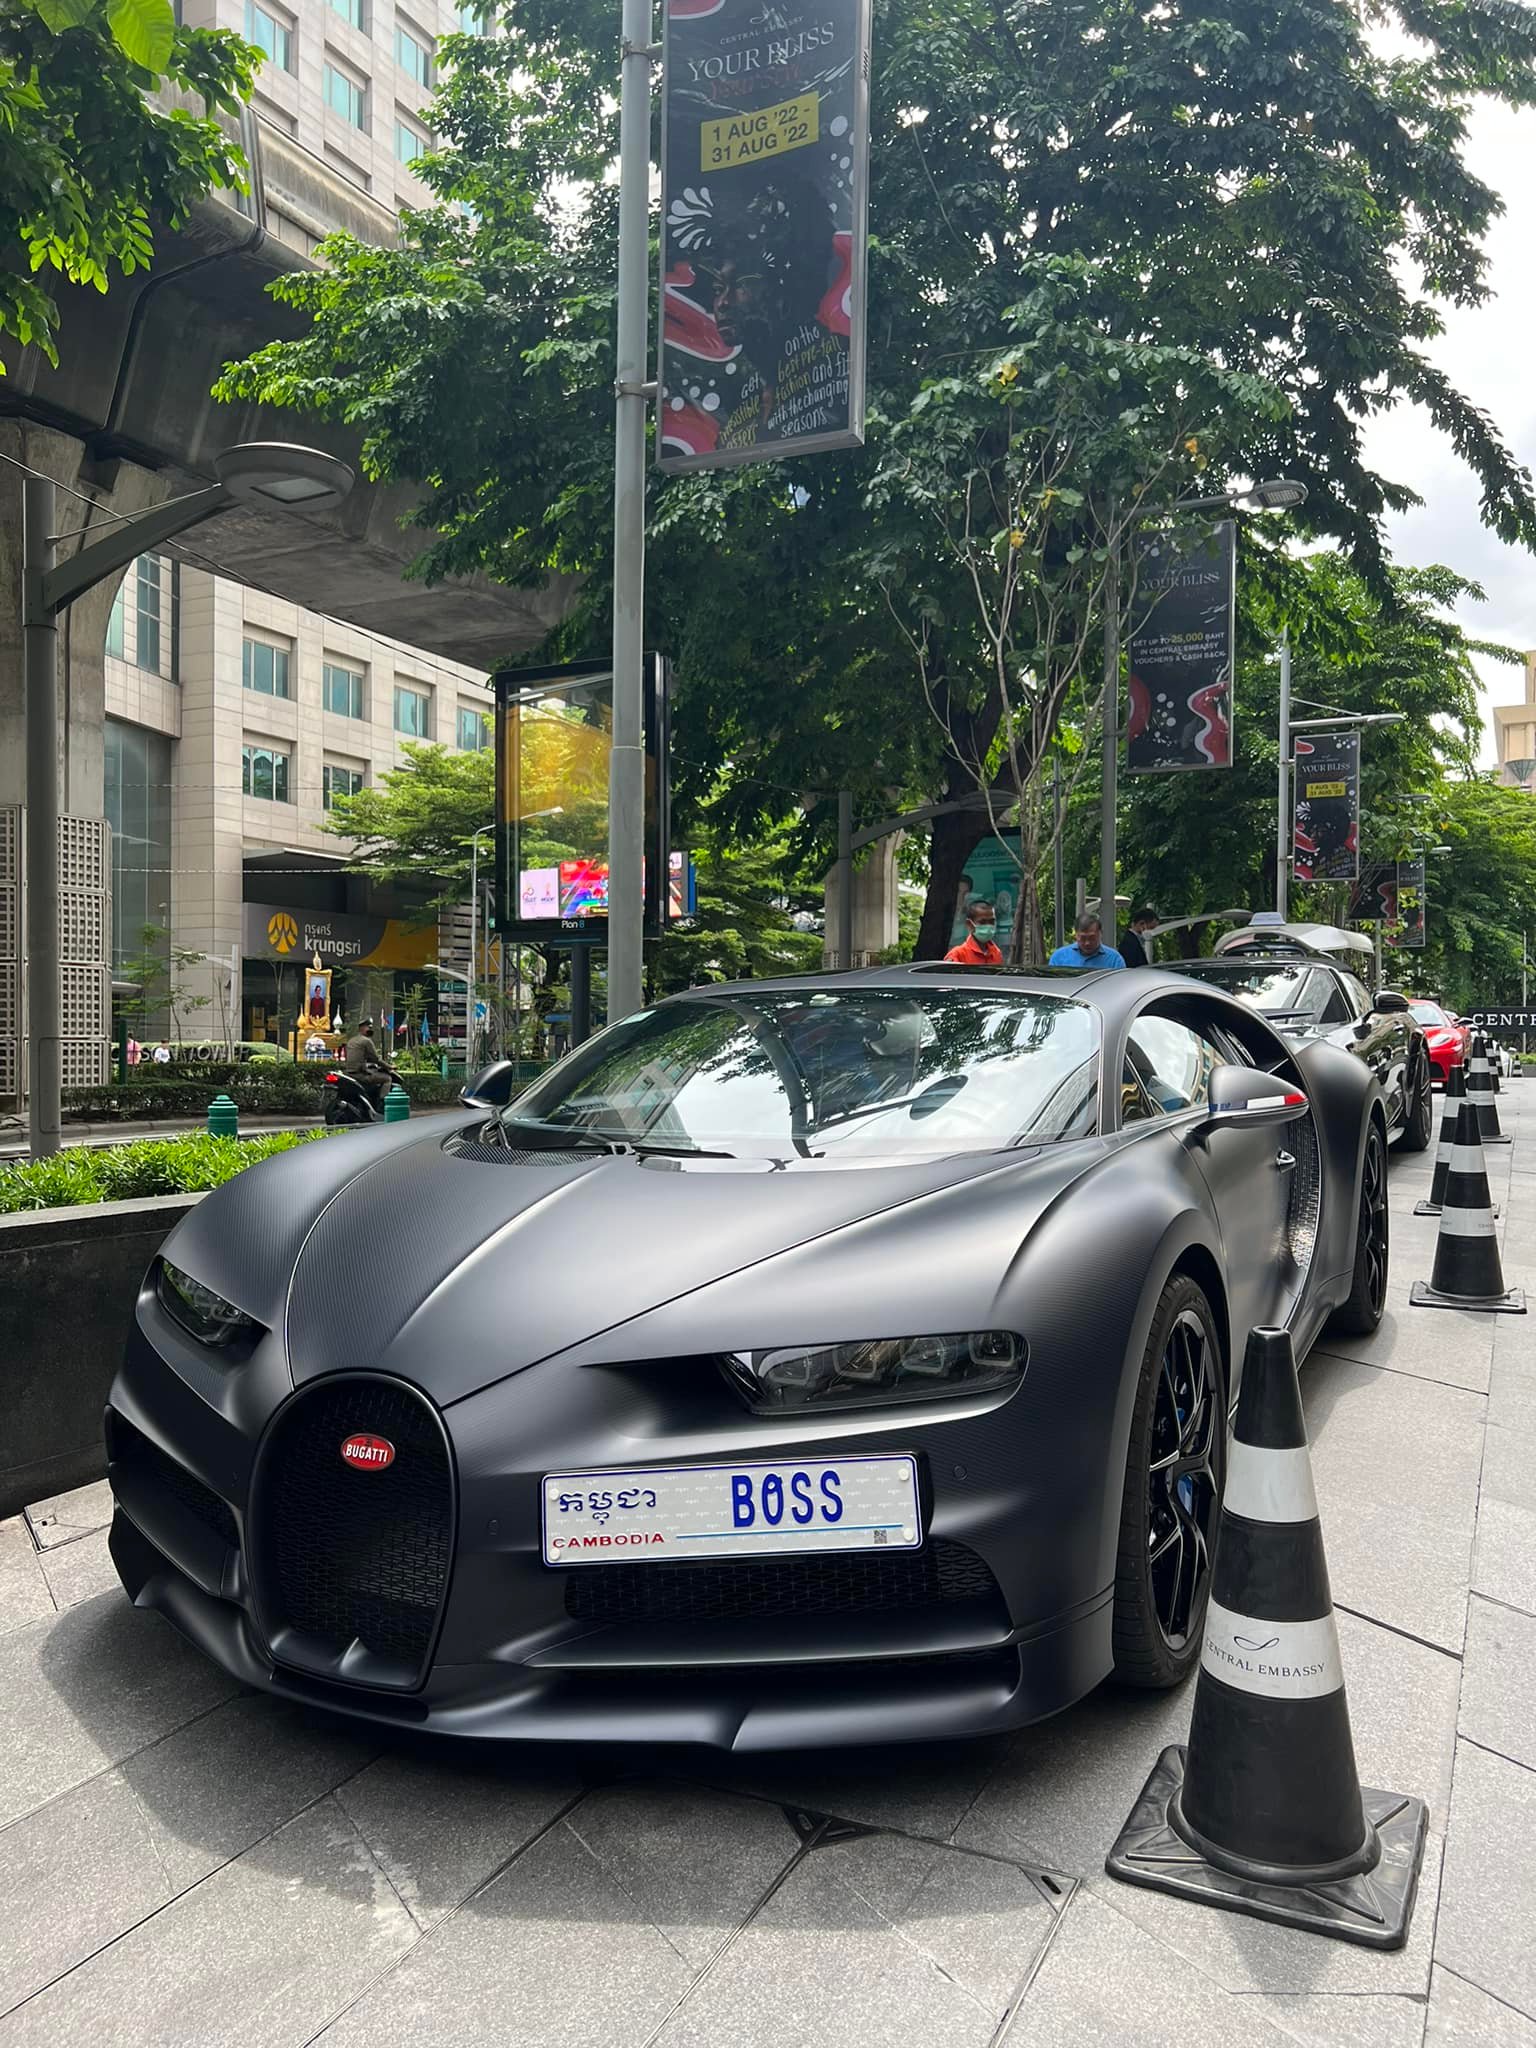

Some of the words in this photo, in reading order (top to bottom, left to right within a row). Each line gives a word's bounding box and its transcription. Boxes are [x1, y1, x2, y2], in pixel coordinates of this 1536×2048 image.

[720, 29, 760, 45] CENTRAL
[688, 48, 760, 82] YOUR
[767, 22, 834, 65] BLISS
[713, 126, 721, 141] 1
[728, 116, 768, 139] AUG
[712, 145, 731, 163] 31
[738, 133, 777, 158] AUG
[785, 336, 800, 356] on
[799, 326, 819, 346] the
[812, 354, 832, 384] and
[768, 405, 788, 430] with
[788, 396, 803, 417] the
[803, 380, 849, 408] changing
[1182, 573, 1220, 586] BLISS
[1170, 632, 1204, 644] 25,000
[561, 920, 578, 929] Plan
[305, 934, 360, 957] krungsri
[345, 1444, 388, 1463] BUGATTI
[731, 1470, 844, 1528] BOSS
[552, 1533, 665, 1549] CAMBODIA
[1258, 1662, 1325, 1677] EMBASSY
